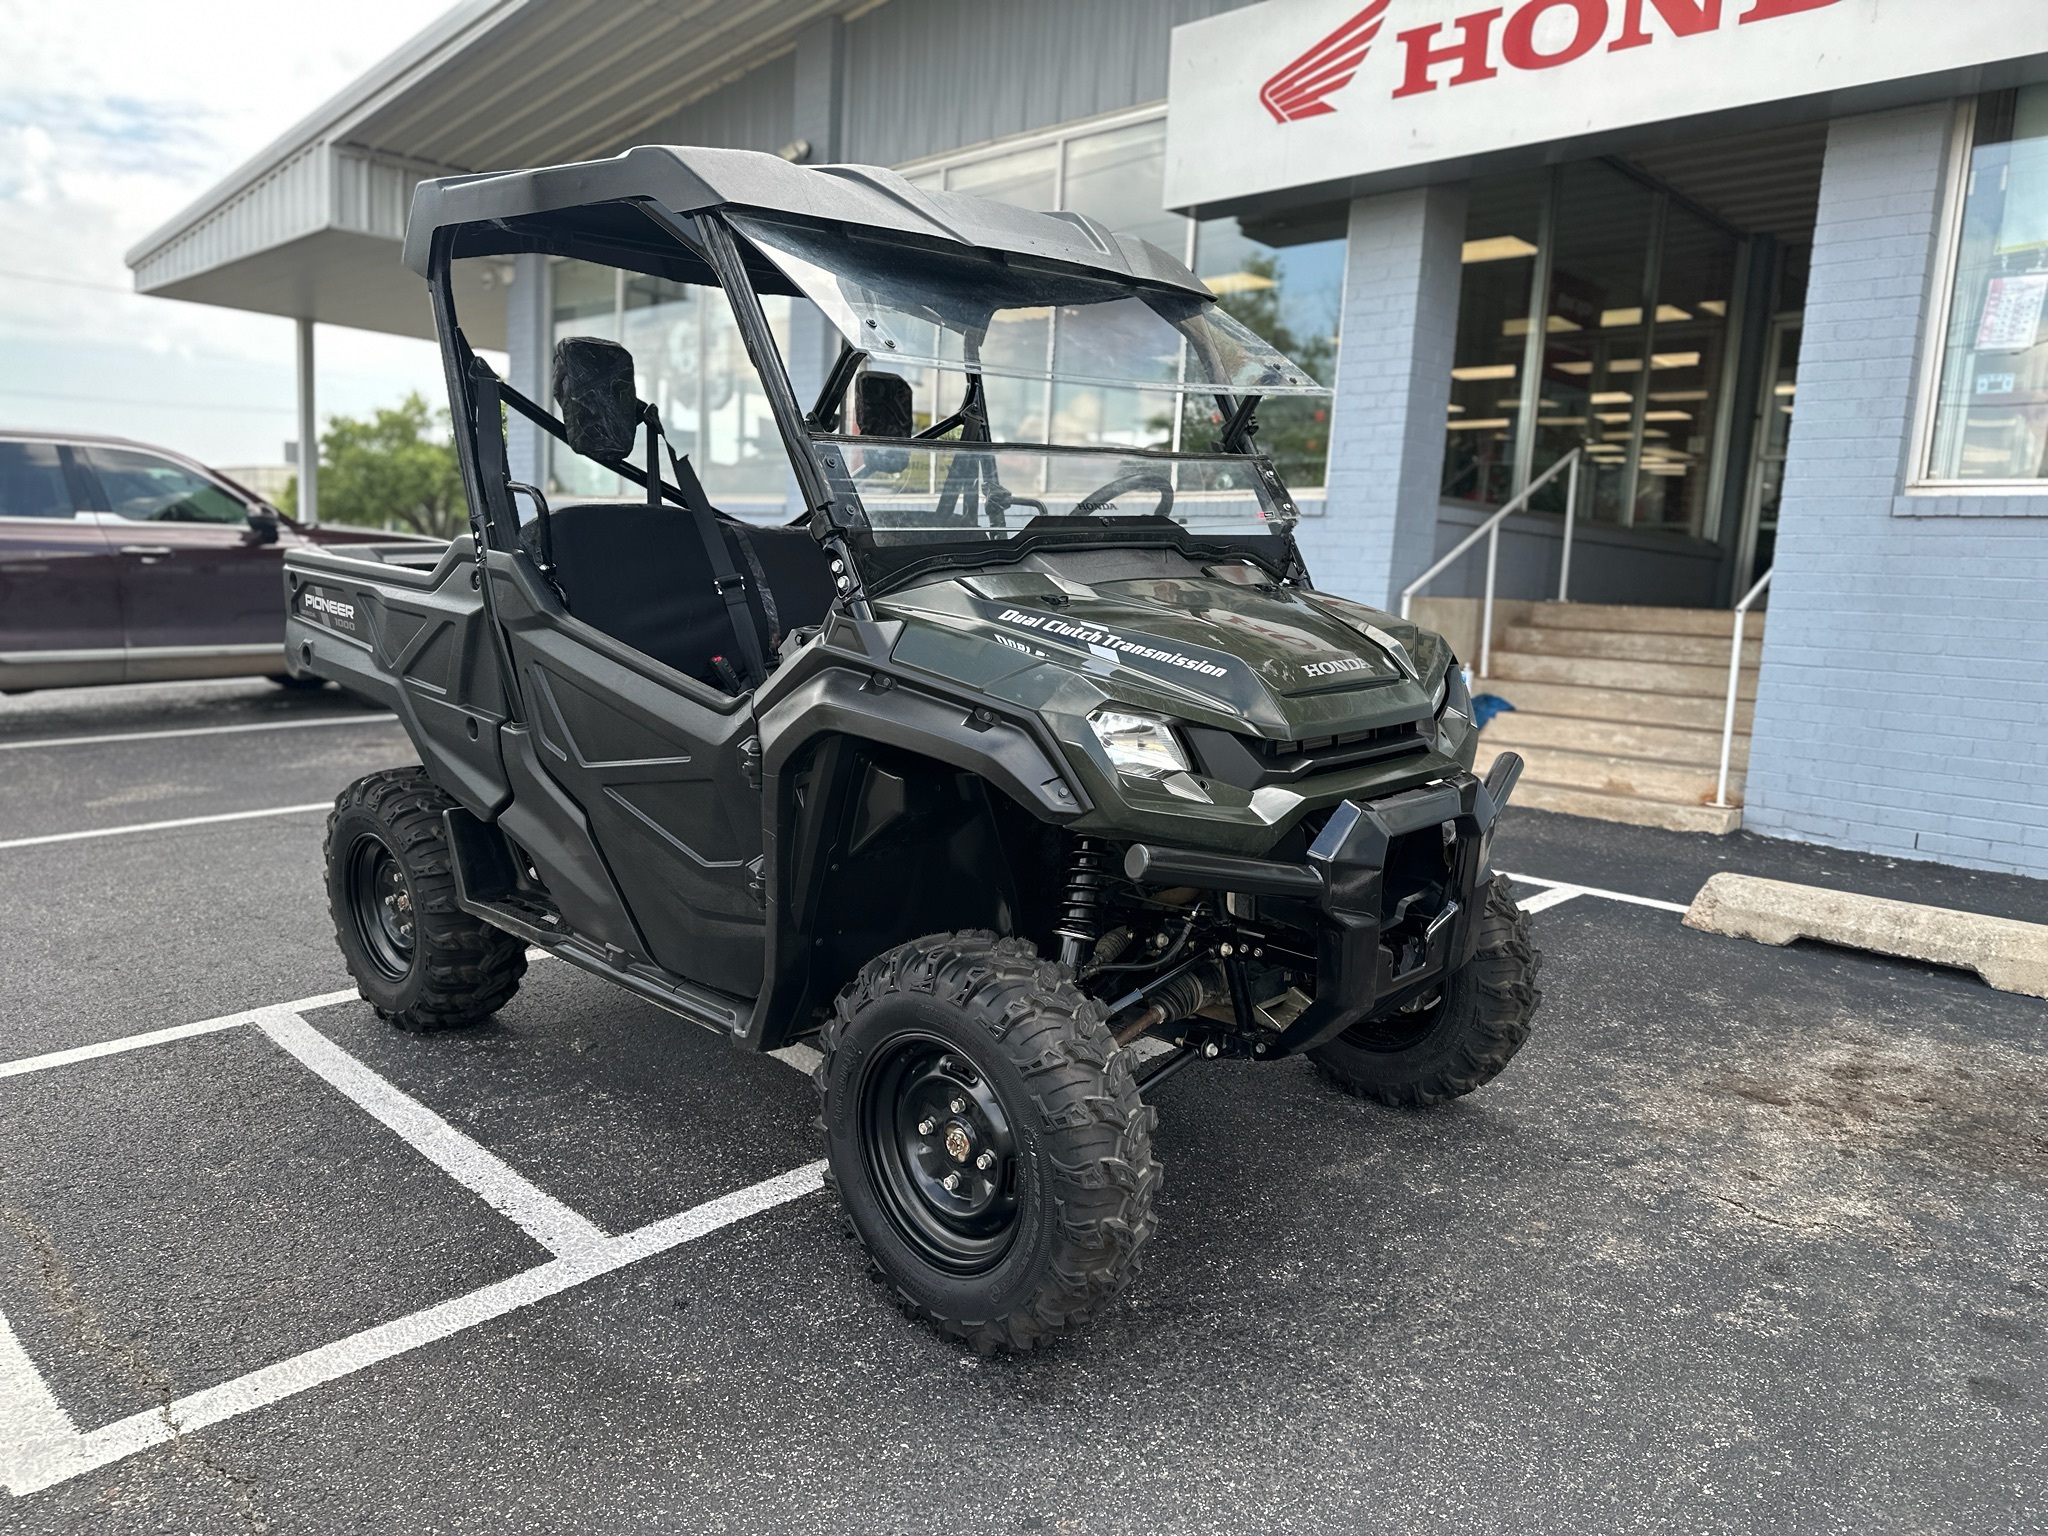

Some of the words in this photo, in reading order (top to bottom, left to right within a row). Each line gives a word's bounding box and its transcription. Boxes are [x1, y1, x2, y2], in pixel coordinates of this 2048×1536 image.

[1076, 502, 1118, 511] HONDA
[305, 594, 354, 619] PIONEER
[334, 618, 355, 631] 1000
[998, 609, 1047, 628] Dual
[1042, 620, 1103, 643] Clutch
[1101, 634, 1228, 678] Transmission
[1301, 657, 1374, 678] HONDA
